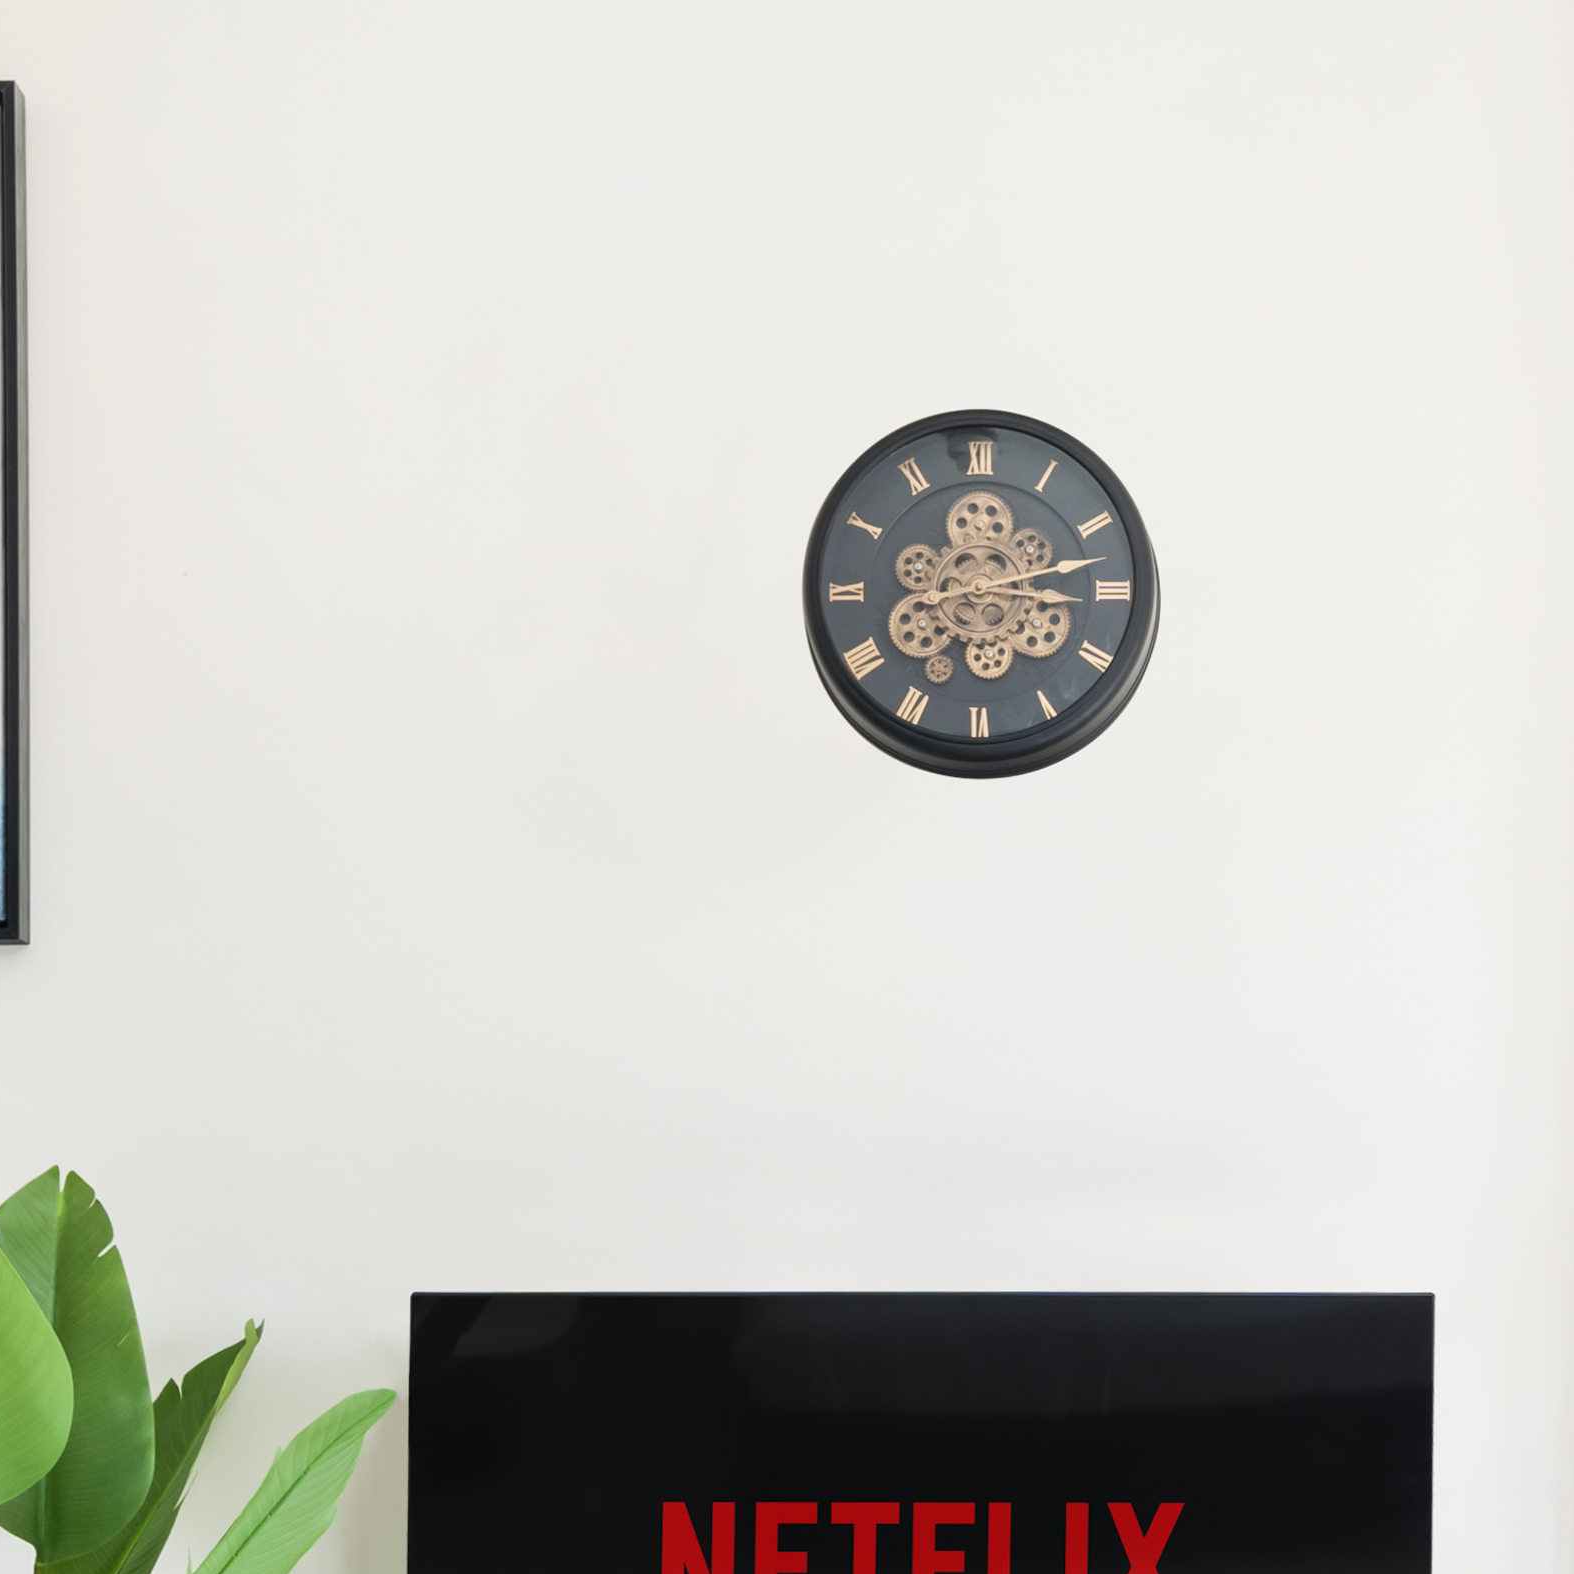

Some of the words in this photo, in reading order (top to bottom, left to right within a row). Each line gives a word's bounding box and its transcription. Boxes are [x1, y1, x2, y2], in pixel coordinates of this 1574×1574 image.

[966, 441, 994, 475] XII
[897, 457, 930, 495] XI
[1034, 459, 1058, 492] I
[846, 511, 883, 539] X
[1077, 510, 1113, 539] II
[829, 581, 864, 602] IX
[1095, 579, 1130, 601] III
[843, 636, 885, 681] VIII
[896, 685, 929, 725] VII
[1036, 690, 1057, 720] V
[969, 707, 990, 738] VI
